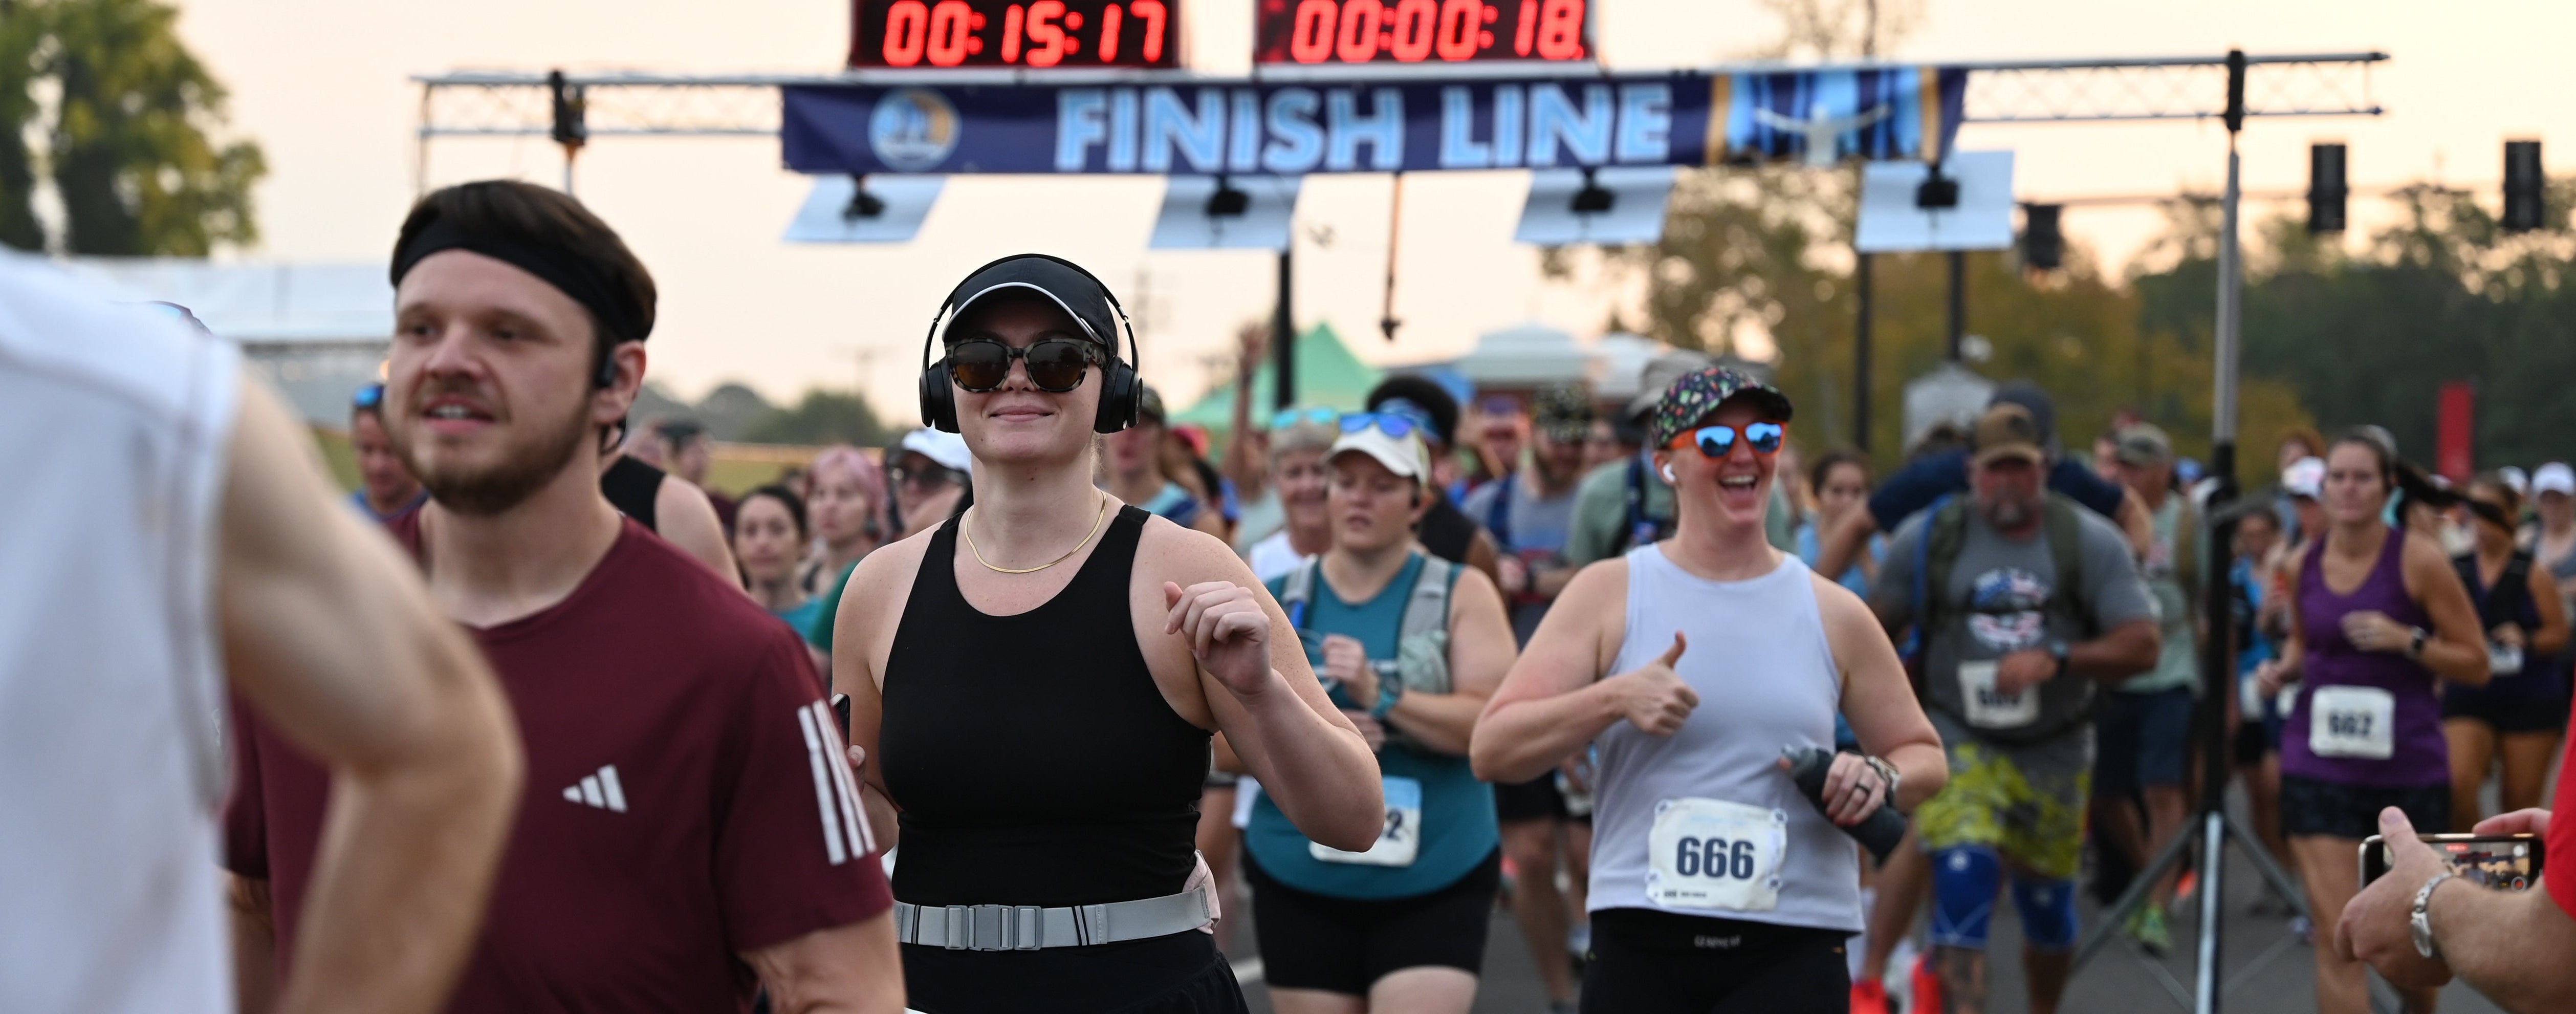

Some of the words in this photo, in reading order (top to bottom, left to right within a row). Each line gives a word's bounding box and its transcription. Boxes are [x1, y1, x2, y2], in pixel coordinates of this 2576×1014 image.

[883, 0, 1166, 67] 00:15:17
[1055, 87, 1404, 172] FINISH
[1439, 83, 1671, 168] LINE
[1676, 836, 1754, 880] 666
